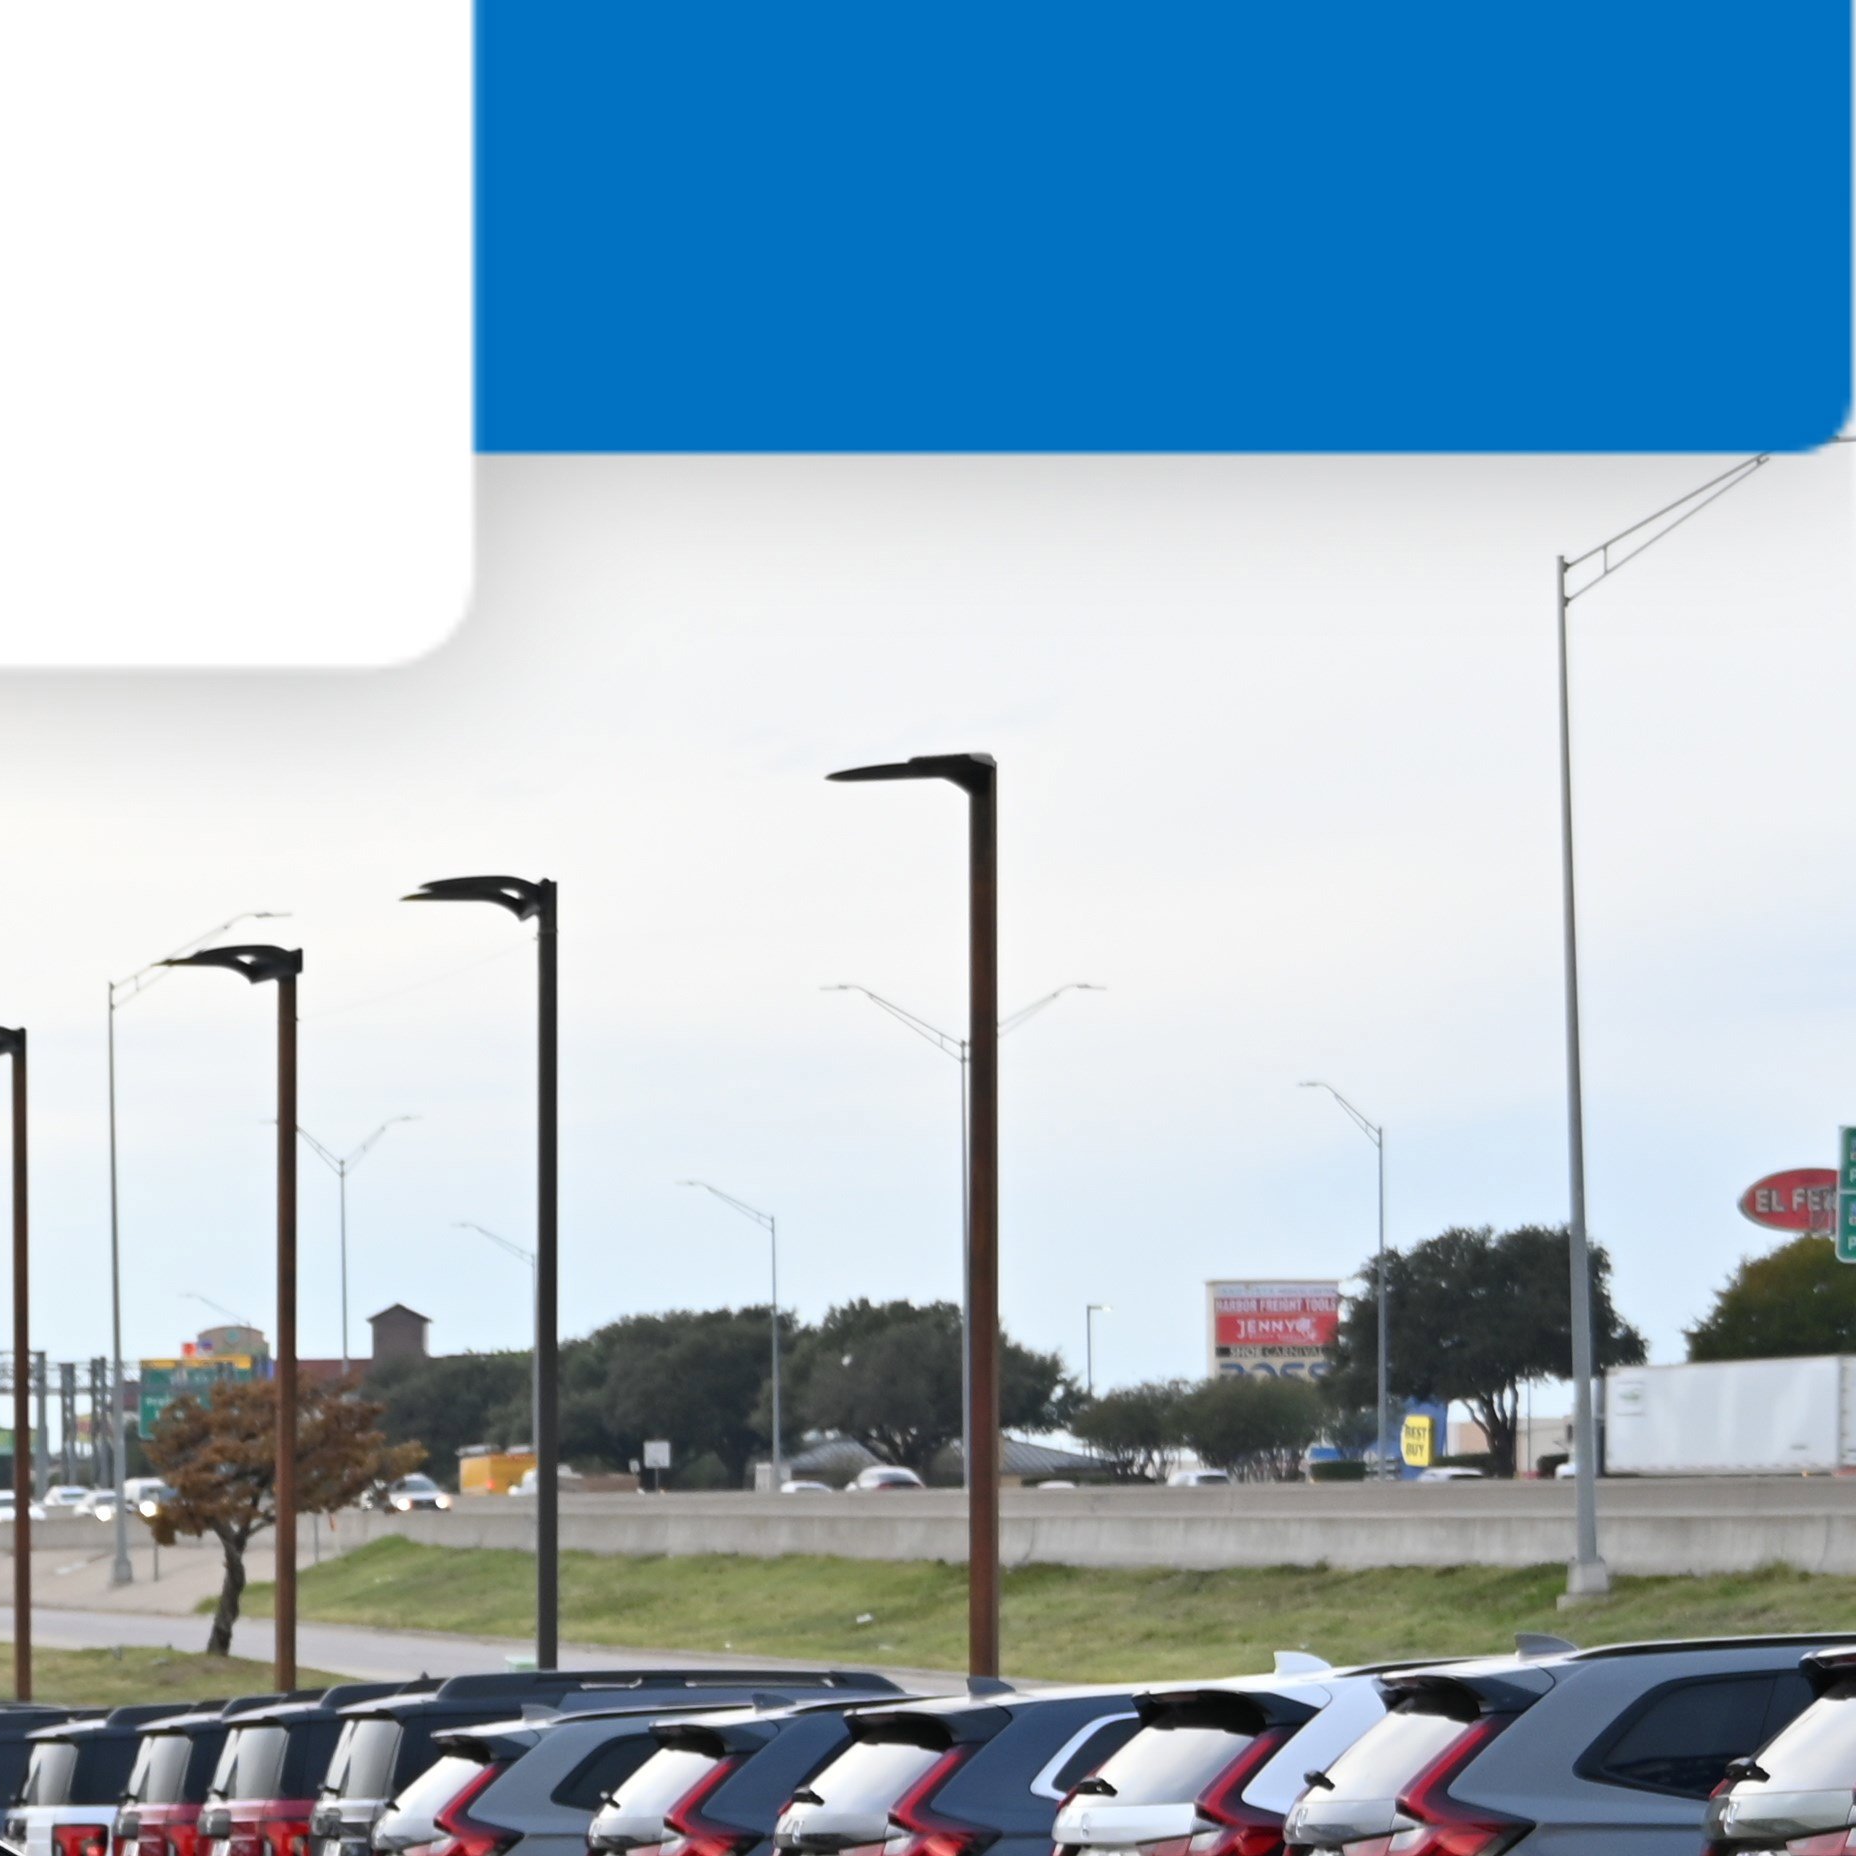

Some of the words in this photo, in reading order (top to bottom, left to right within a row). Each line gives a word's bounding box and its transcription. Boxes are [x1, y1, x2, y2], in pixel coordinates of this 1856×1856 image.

[1755, 1188, 1784, 1213] EL
[1216, 1298, 1257, 1312] HARBOR
[1259, 1298, 1302, 1312] FREIGHT
[1305, 1298, 1337, 1312] TOOLS
[1237, 1318, 1297, 1339] JENNY
